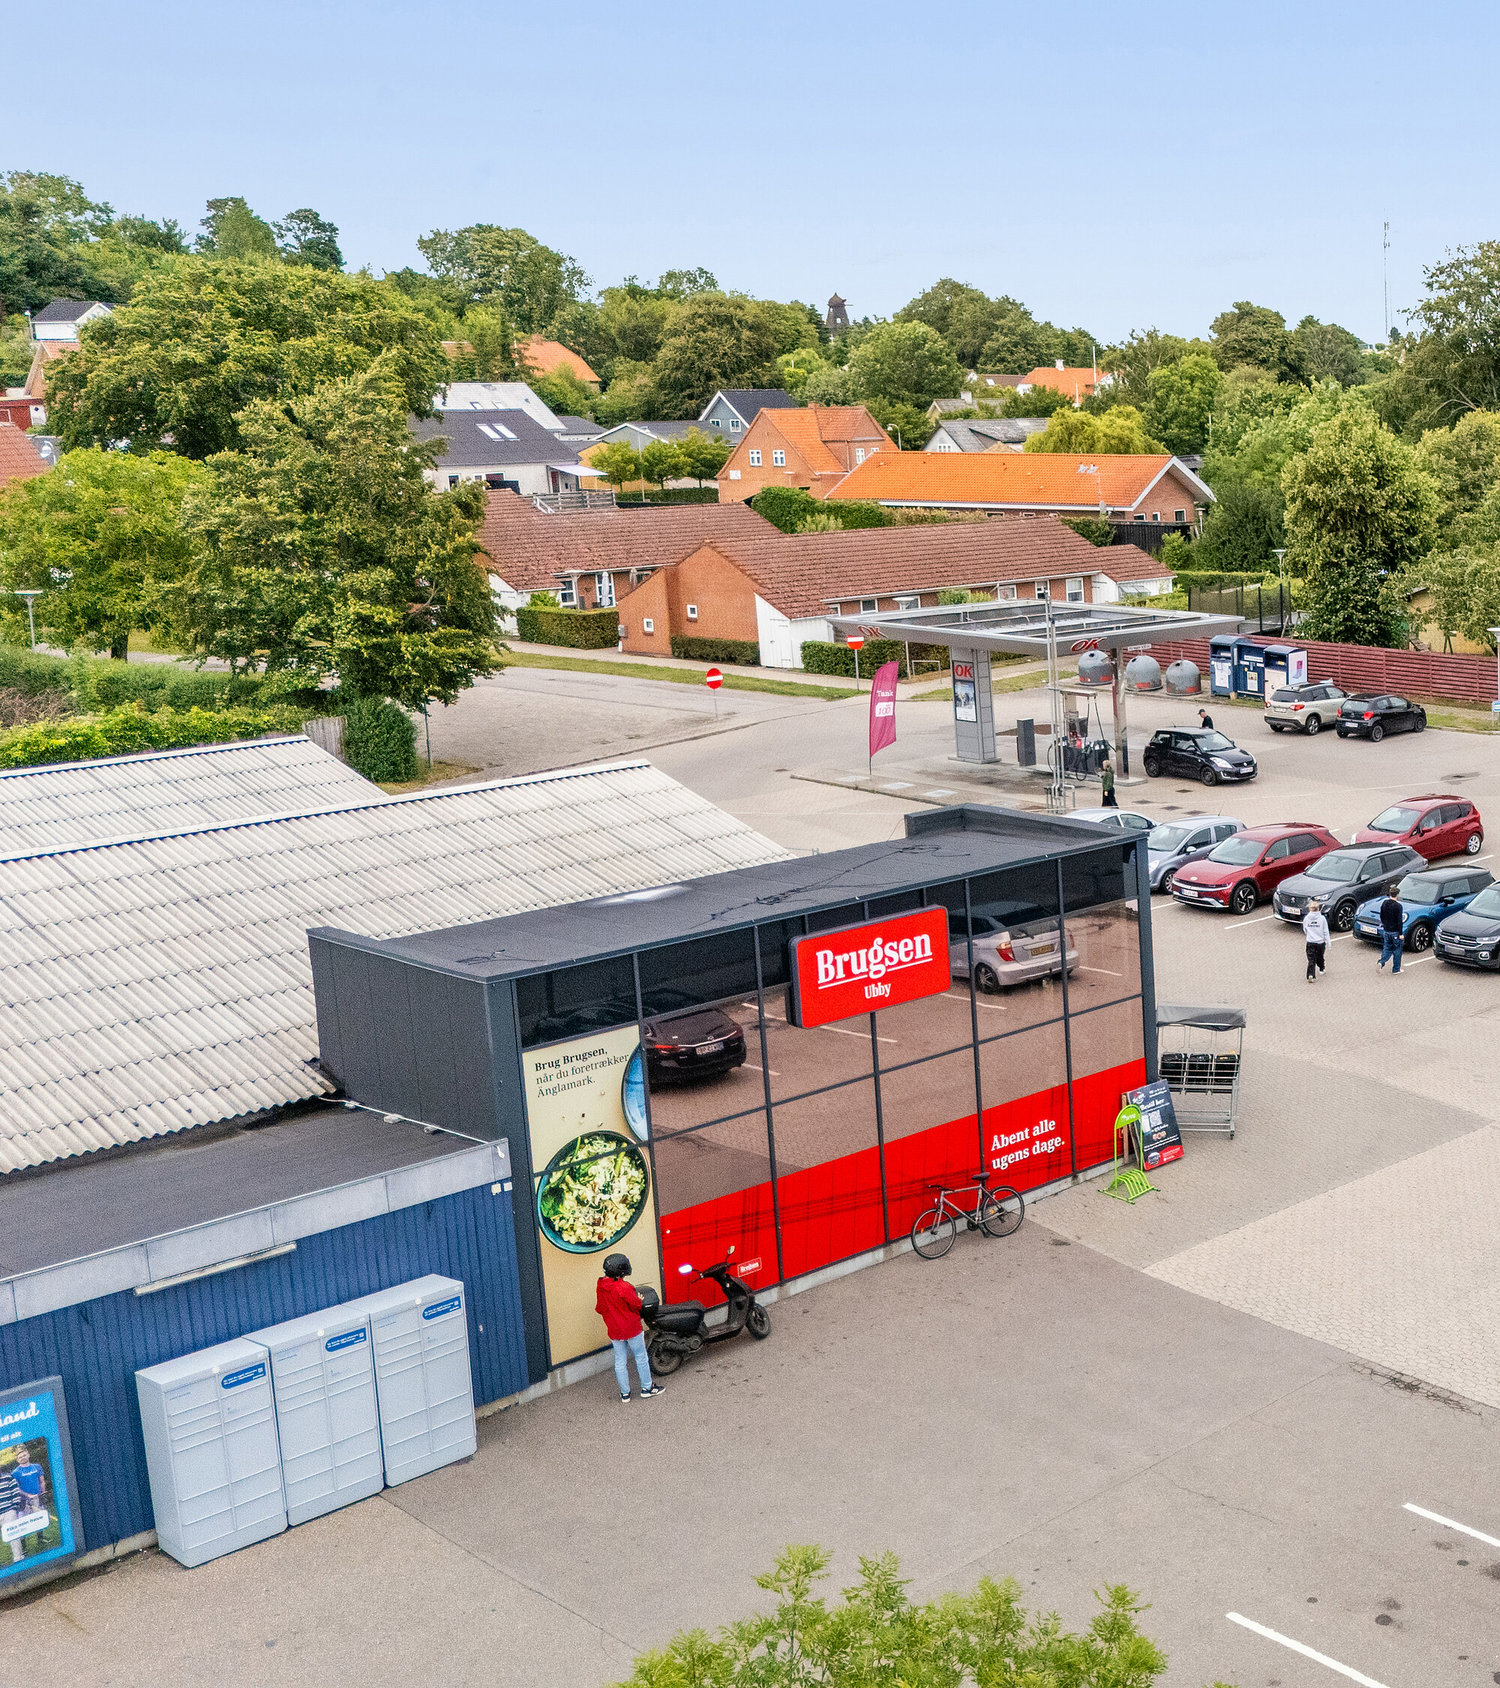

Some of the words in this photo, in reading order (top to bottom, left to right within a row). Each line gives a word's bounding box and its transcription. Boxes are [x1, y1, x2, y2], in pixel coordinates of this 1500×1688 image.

[858, 625, 888, 638] OK
[1071, 637, 1107, 652] OK
[954, 664, 973, 678] OK
[816, 933, 933, 984] Brugsen
[864, 983, 892, 999] Ubby
[535, 1059, 561, 1072] Brug
[563, 1047, 608, 1065] Brugsen,
[536, 1074, 554, 1085] når
[556, 1069, 569, 1080] du
[571, 1054, 630, 1076] foretrækker
[537, 1075, 596, 1098] Änglamark.
[991, 1127, 1030, 1152] Åbent
[1032, 1119, 1056, 1137] alle
[992, 1147, 1030, 1170] ugens
[1032, 1136, 1065, 1155] dage.
